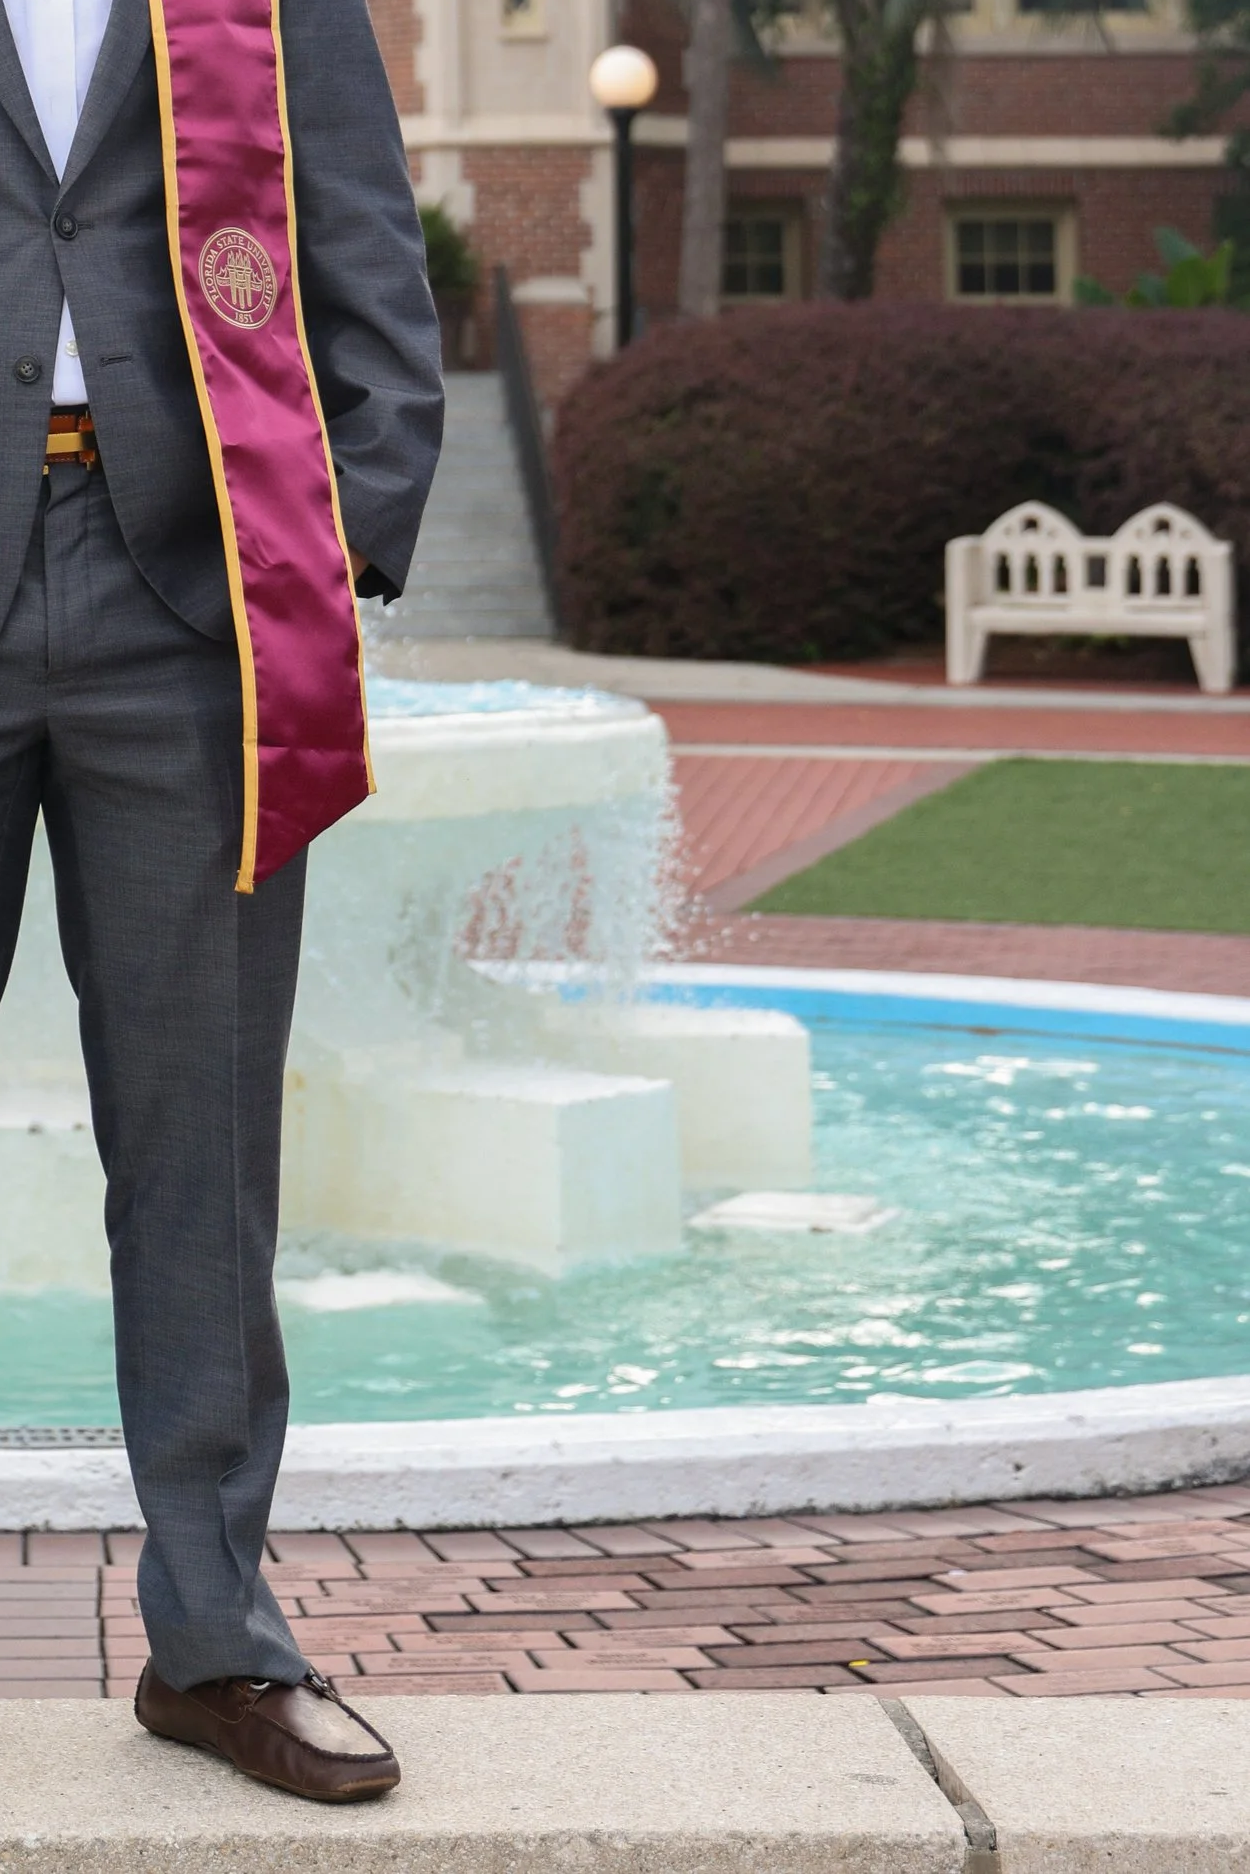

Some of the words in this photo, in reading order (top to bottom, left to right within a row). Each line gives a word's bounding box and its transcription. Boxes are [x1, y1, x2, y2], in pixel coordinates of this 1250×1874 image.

[204, 249, 219, 302] FLORIDA
[217, 235, 246, 249] STATE
[247, 241, 273, 310] UNIVERSITY
[235, 312, 254, 323] 1851
